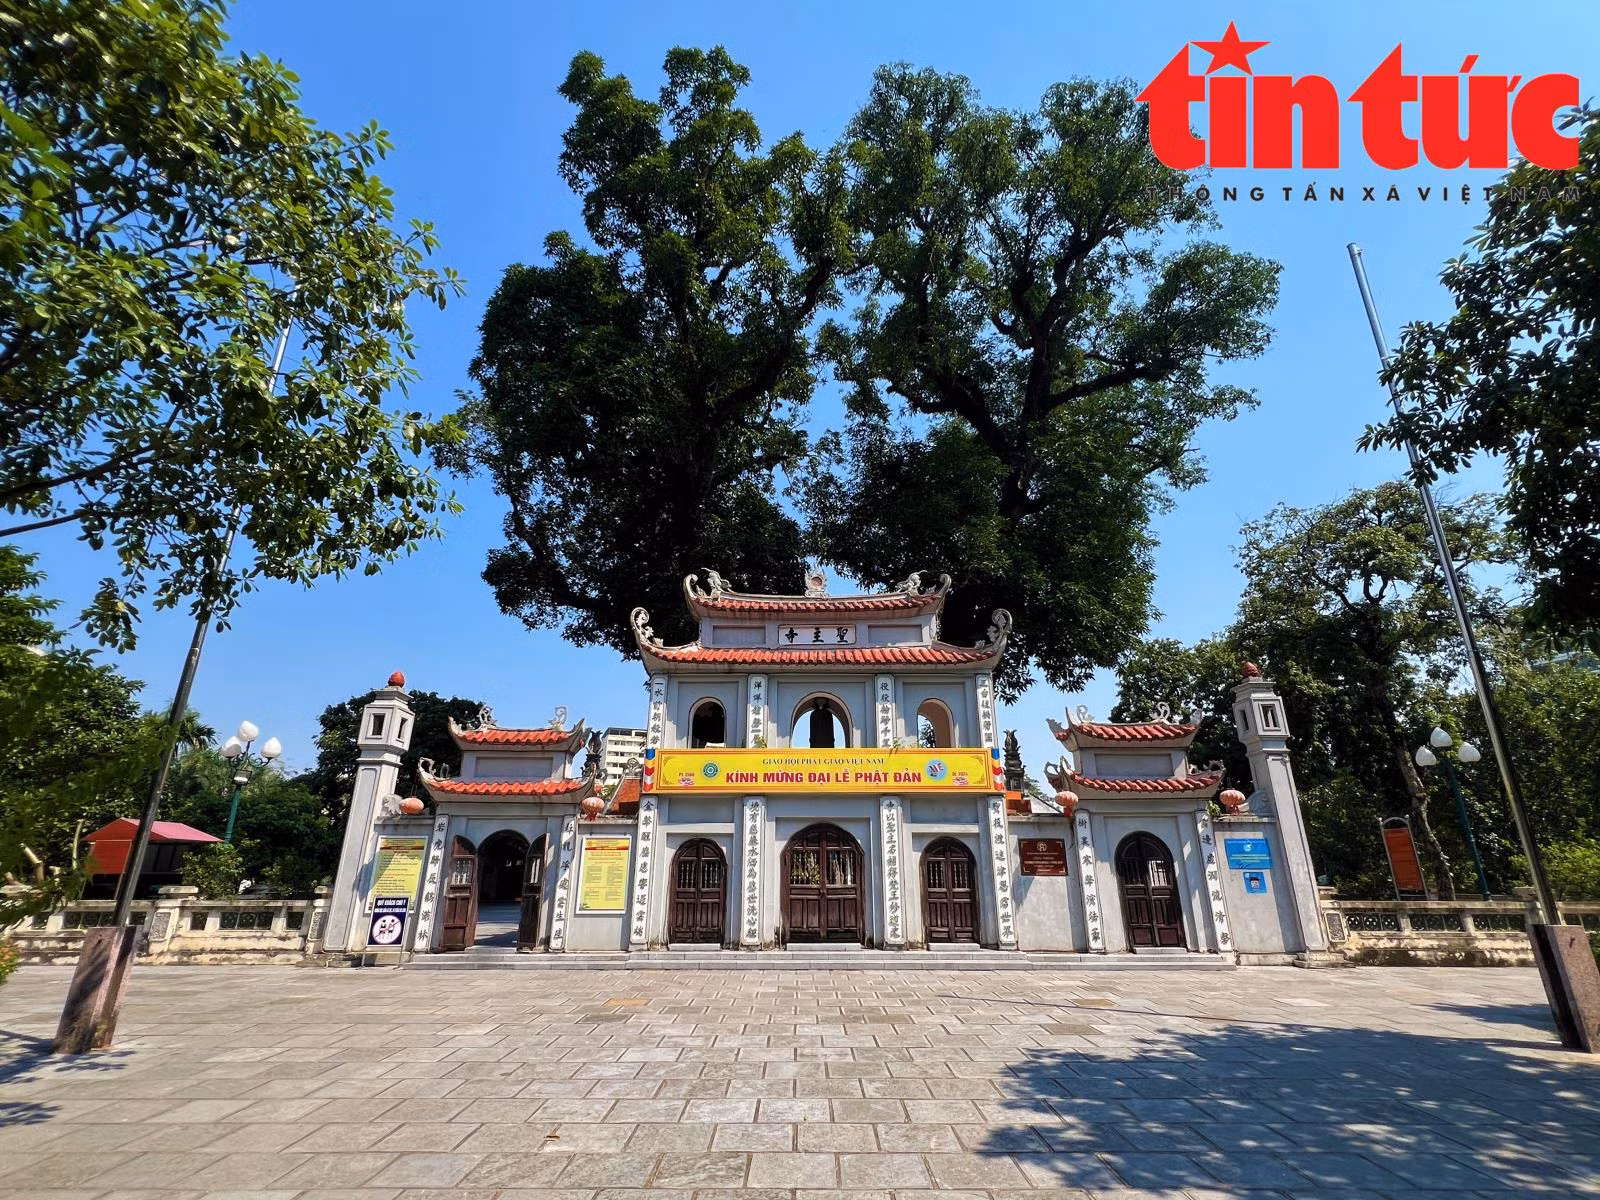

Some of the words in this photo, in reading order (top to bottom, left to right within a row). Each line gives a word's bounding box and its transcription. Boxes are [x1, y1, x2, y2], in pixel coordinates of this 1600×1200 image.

[726, 770, 758, 783] KÍNH
[763, 769, 803, 783] MỪNG
[808, 772, 830, 785] ĐẠI
[835, 768, 850, 783] LỄ
[854, 769, 889, 785] PHẬT
[893, 767, 922, 783] ĐẢN
